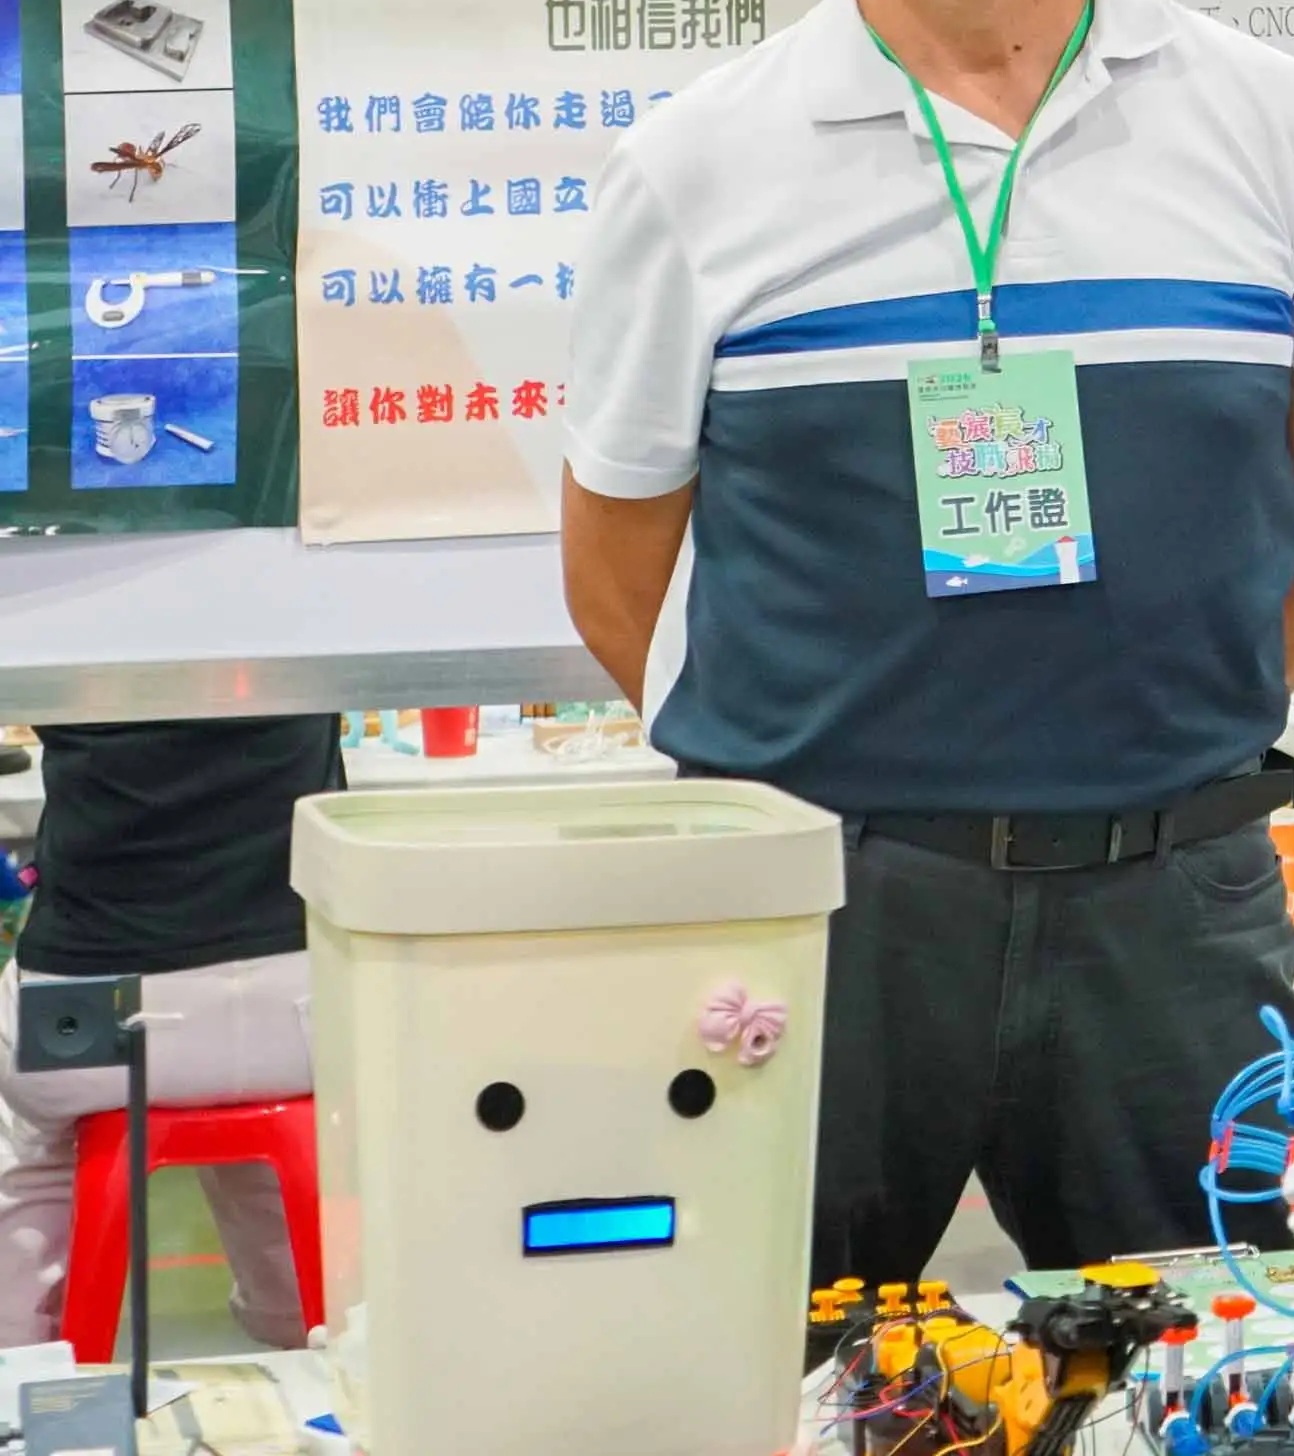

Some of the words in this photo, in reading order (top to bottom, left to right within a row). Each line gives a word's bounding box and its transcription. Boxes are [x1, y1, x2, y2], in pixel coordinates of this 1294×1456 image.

[319, 175, 589, 221] 可以衝上國立
[322, 378, 567, 428] 讓你對未來
[940, 487, 1069, 537] 工作證
